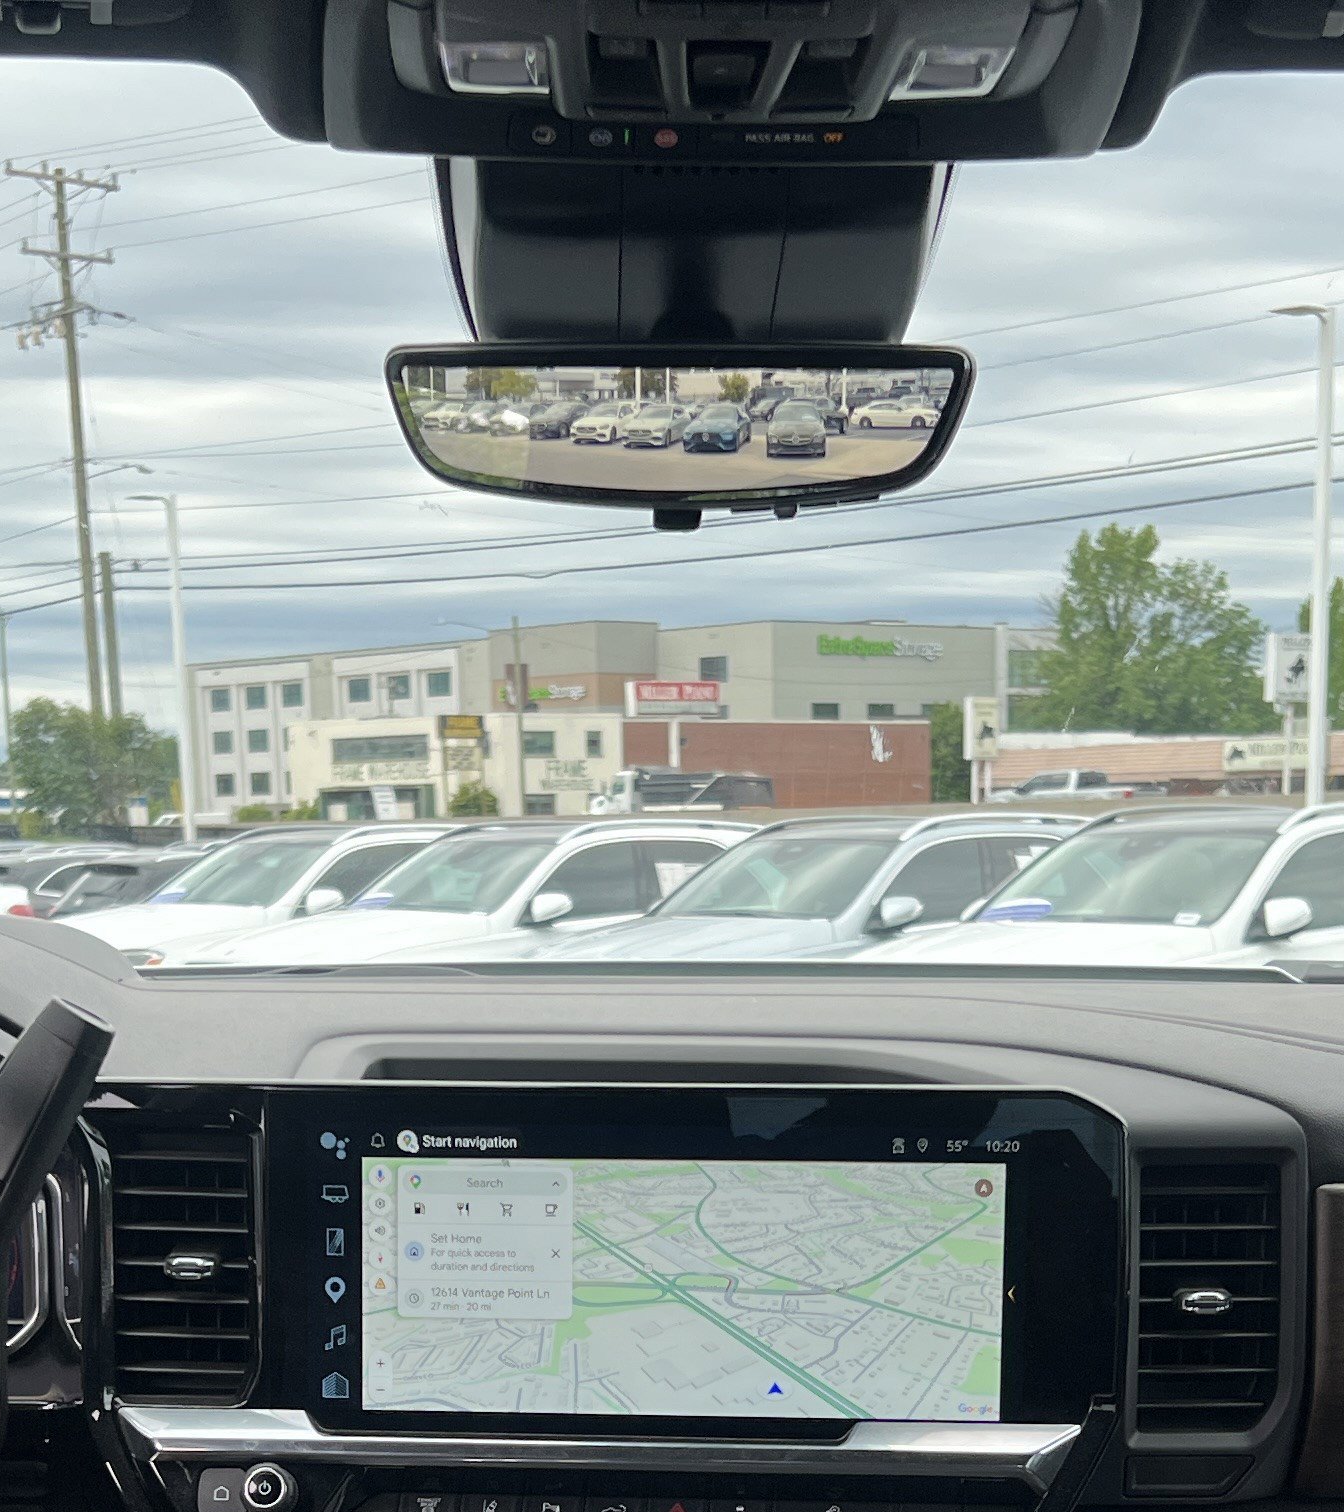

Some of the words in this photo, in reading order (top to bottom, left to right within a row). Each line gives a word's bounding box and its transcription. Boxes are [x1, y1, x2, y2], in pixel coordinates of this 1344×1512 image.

[422, 1135, 452, 1148] Start
[454, 1136, 518, 1151] navigation
[986, 1140, 1020, 1153] 10:20
[466, 1177, 504, 1189] Search
[430, 1233, 448, 1244] Set
[451, 1233, 482, 1244] Home
[431, 1248, 445, 1257] For
[447, 1248, 472, 1260] quick
[474, 1249, 506, 1258] access
[507, 1250, 517, 1258] to
[431, 1262, 468, 1272] duration
[470, 1263, 488, 1272] and
[489, 1263, 535, 1273] directions
[430, 1287, 458, 1298] 12614
[460, 1287, 505, 1301] Vantage
[507, 1288, 534, 1299] Point
[536, 1289, 550, 1299] Ln
[430, 1302, 441, 1311] 27
[443, 1303, 460, 1311] min
[466, 1302, 479, 1311] 20
